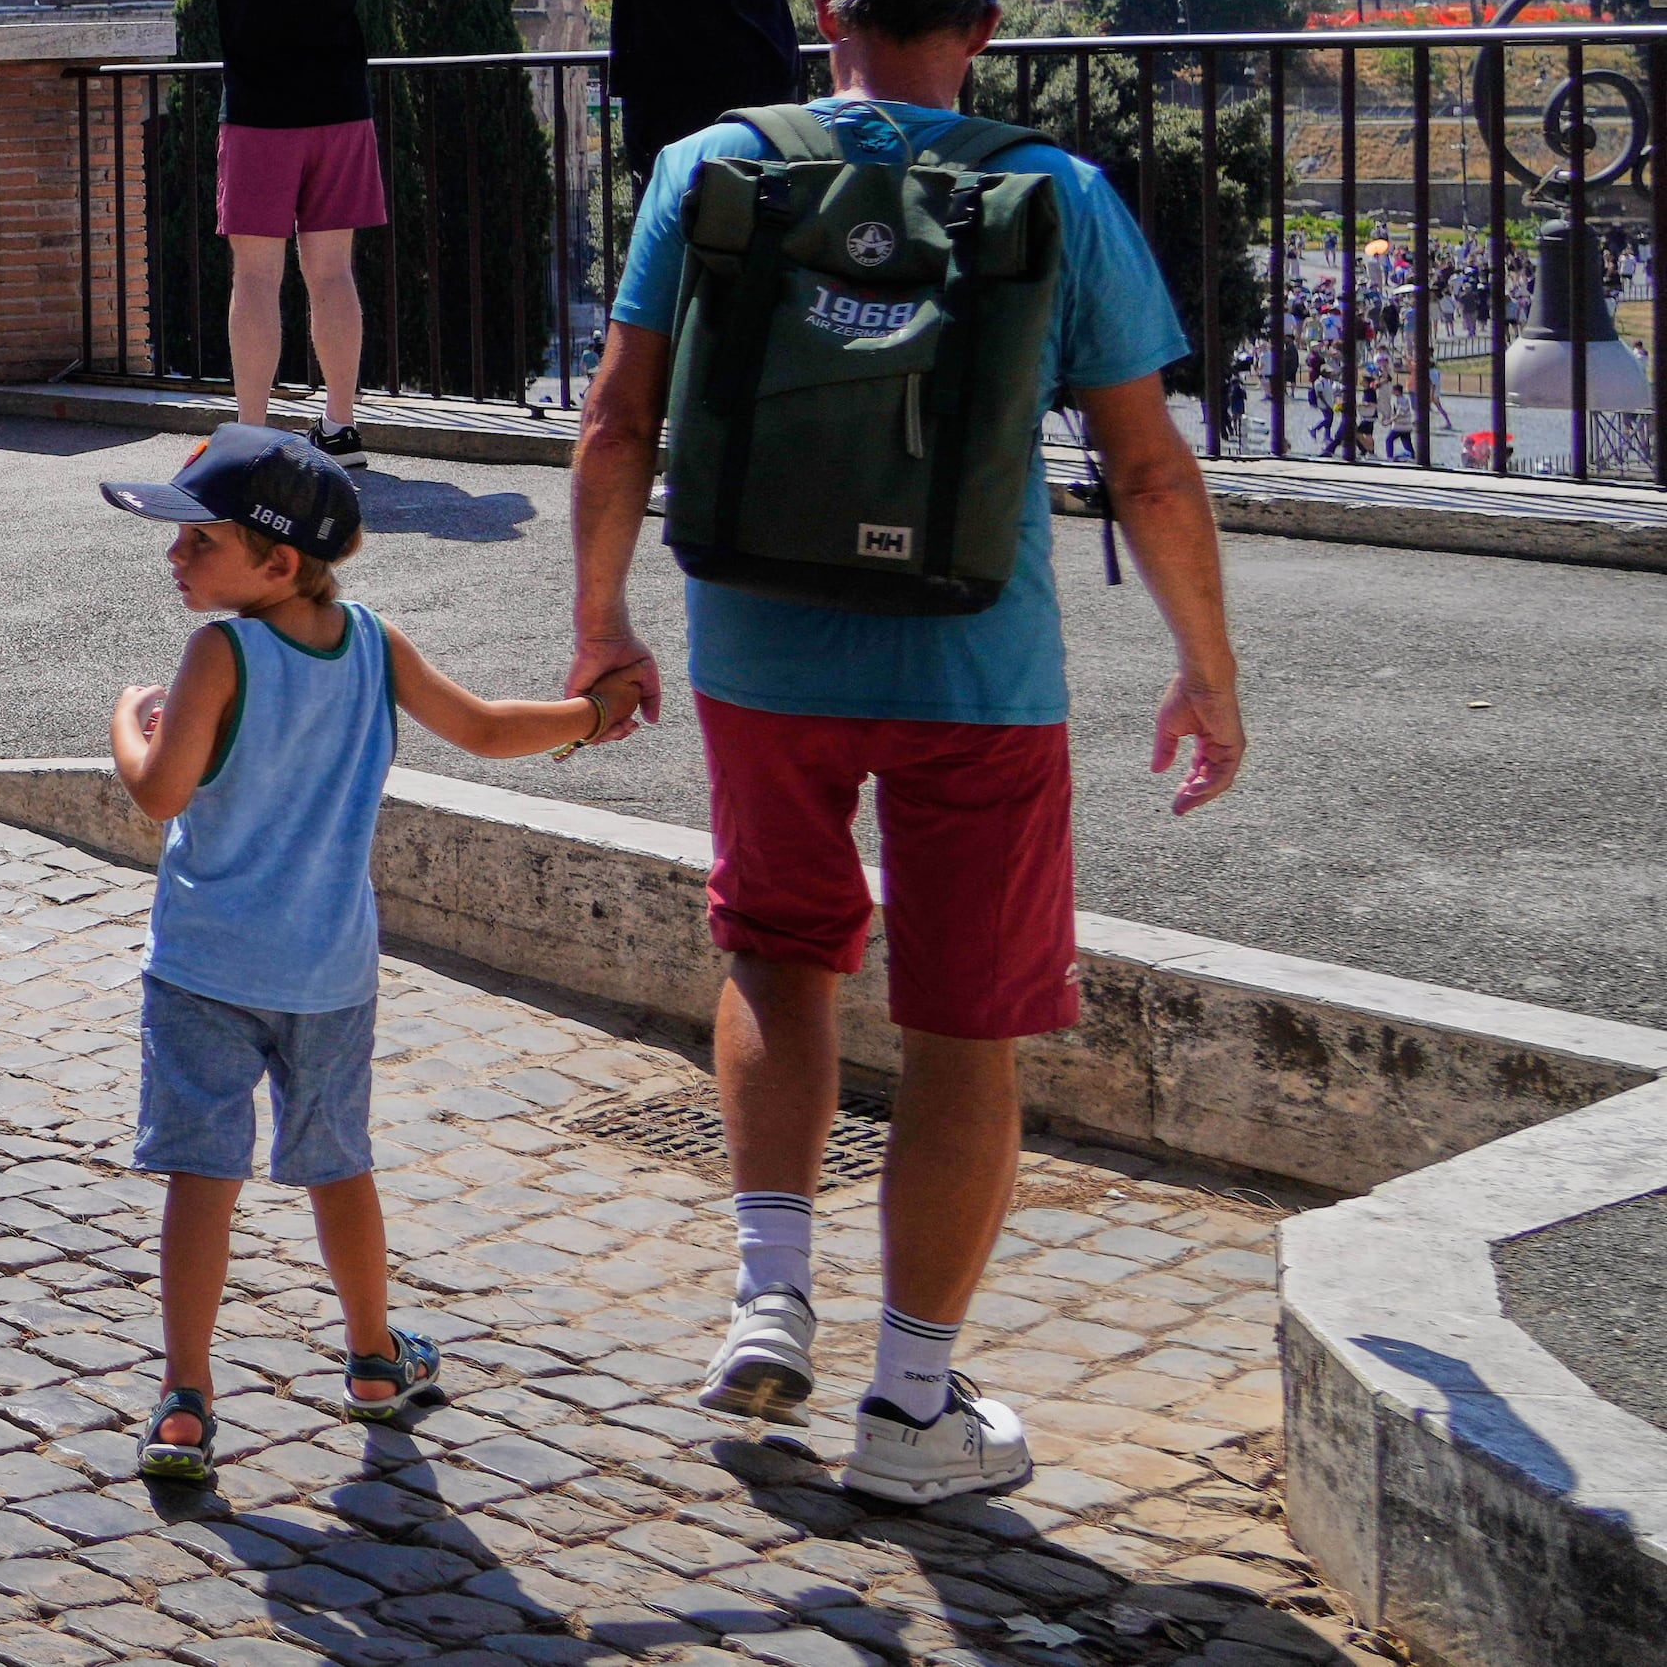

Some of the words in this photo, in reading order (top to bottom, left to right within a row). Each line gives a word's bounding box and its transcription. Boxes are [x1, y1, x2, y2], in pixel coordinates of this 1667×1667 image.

[809, 285, 916, 329] 1968
[805, 315, 831, 330] AIR
[249, 503, 294, 536] 1861
[865, 531, 904, 553] HH
[903, 1370, 948, 1384] SNOC
